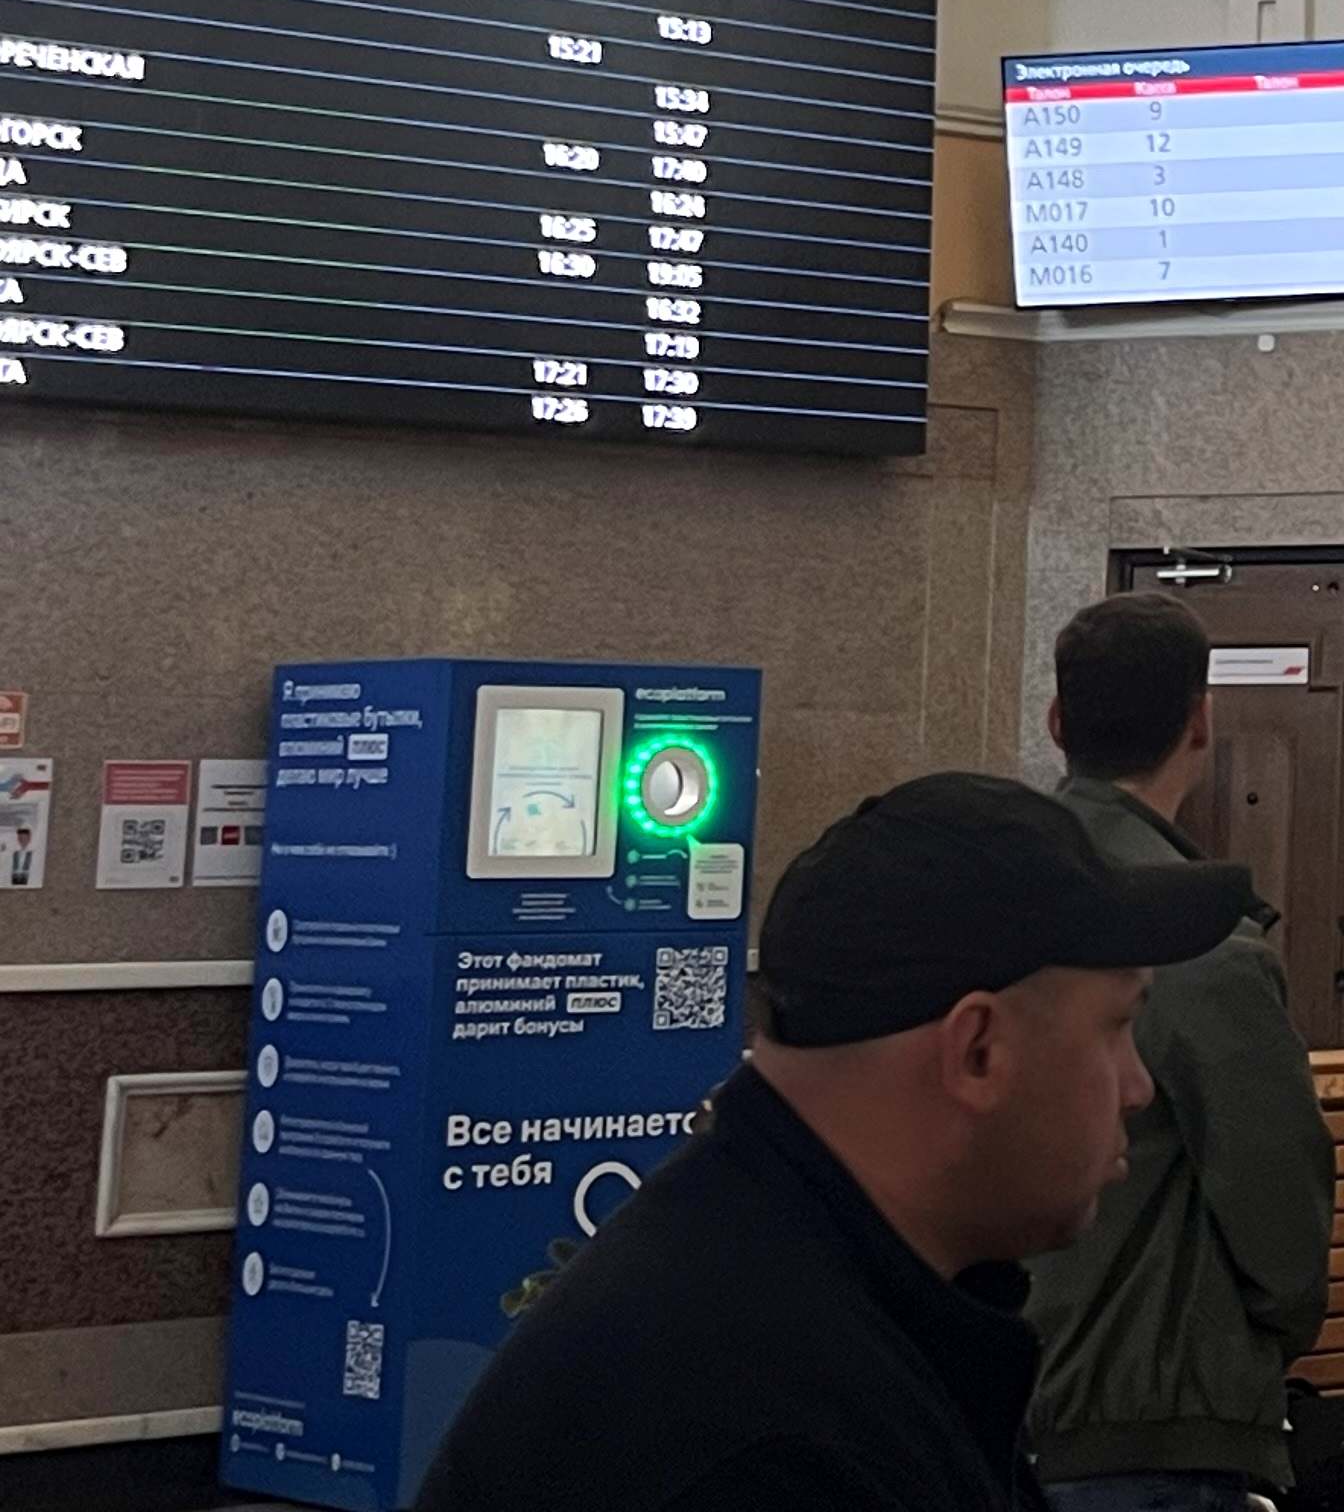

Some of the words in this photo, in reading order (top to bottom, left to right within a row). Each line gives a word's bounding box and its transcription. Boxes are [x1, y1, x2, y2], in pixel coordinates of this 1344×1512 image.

[1015, 62, 1121, 82] Электронная
[1121, 59, 1191, 77] очередь
[1150, 100, 1163, 121] 9
[0, 118, 83, 151] ГОРСК
[1146, 132, 1172, 153] 12
[1153, 164, 1167, 186] 3
[1150, 197, 1176, 218] 10
[1158, 229, 1168, 249] 1
[1157, 260, 1172, 281] 7
[457, 951, 504, 970] Этот
[505, 951, 603, 972] фандомат
[455, 974, 562, 997] принимает
[565, 973, 646, 991] пластик,
[454, 995, 557, 1016] алюминий
[570, 996, 619, 1011] плюс
[451, 1019, 511, 1041] дарит
[513, 1015, 585, 1038] бонусы
[446, 1114, 513, 1148] Все
[443, 1165, 463, 1191] с
[471, 1154, 553, 1189] тебя
